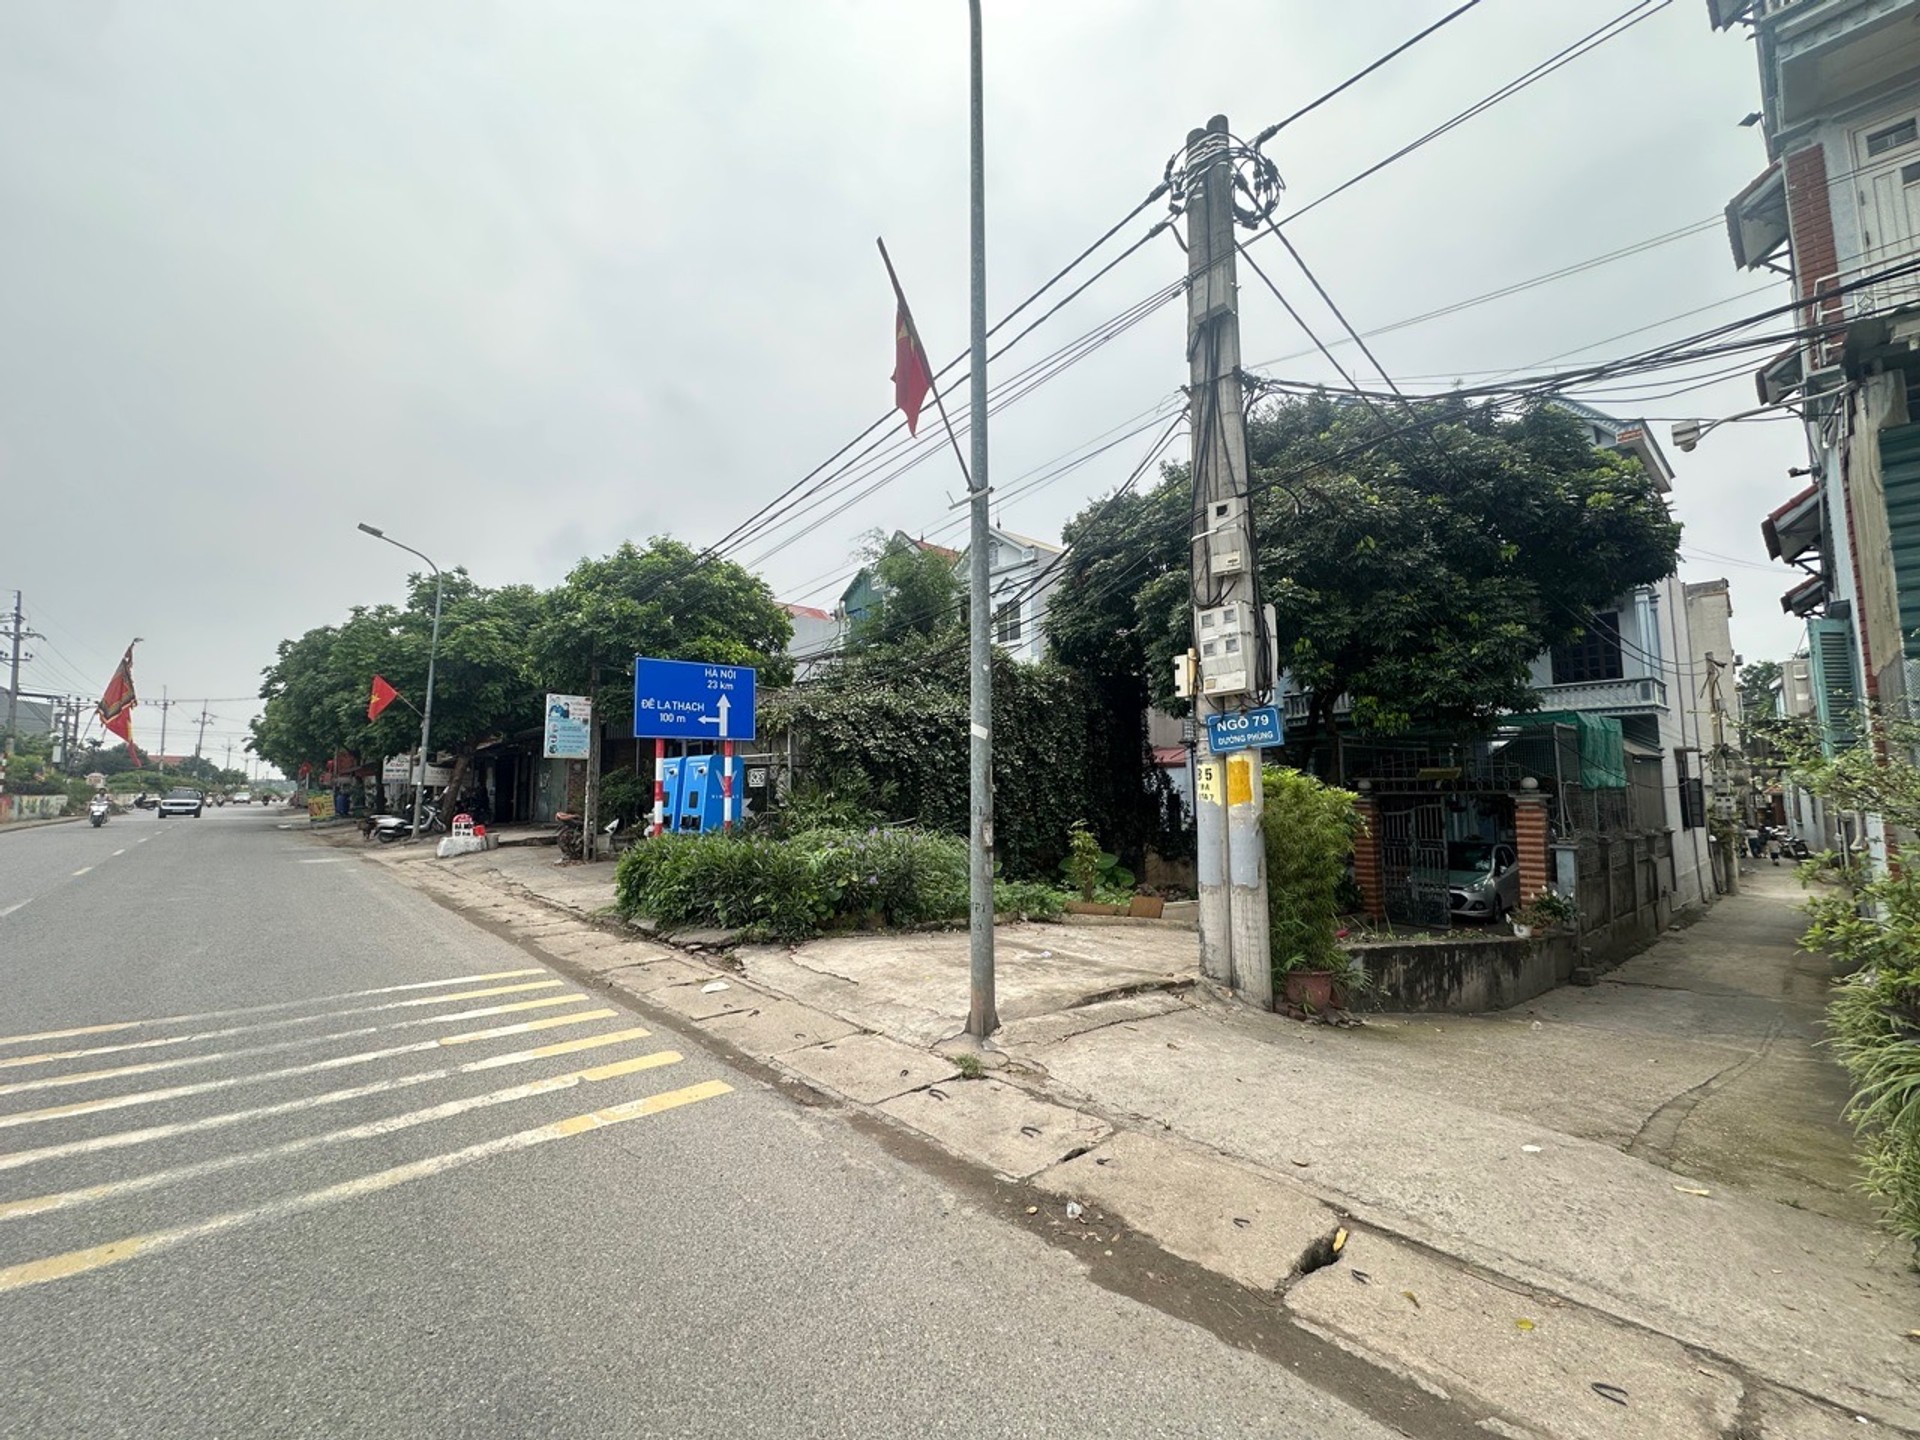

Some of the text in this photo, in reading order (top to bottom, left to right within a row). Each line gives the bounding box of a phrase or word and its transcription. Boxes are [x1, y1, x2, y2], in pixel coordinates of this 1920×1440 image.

[707, 680, 734, 691] 23 km
[660, 713, 686, 723] 100 m
[1216, 714, 1269, 732] NGÕ 79
